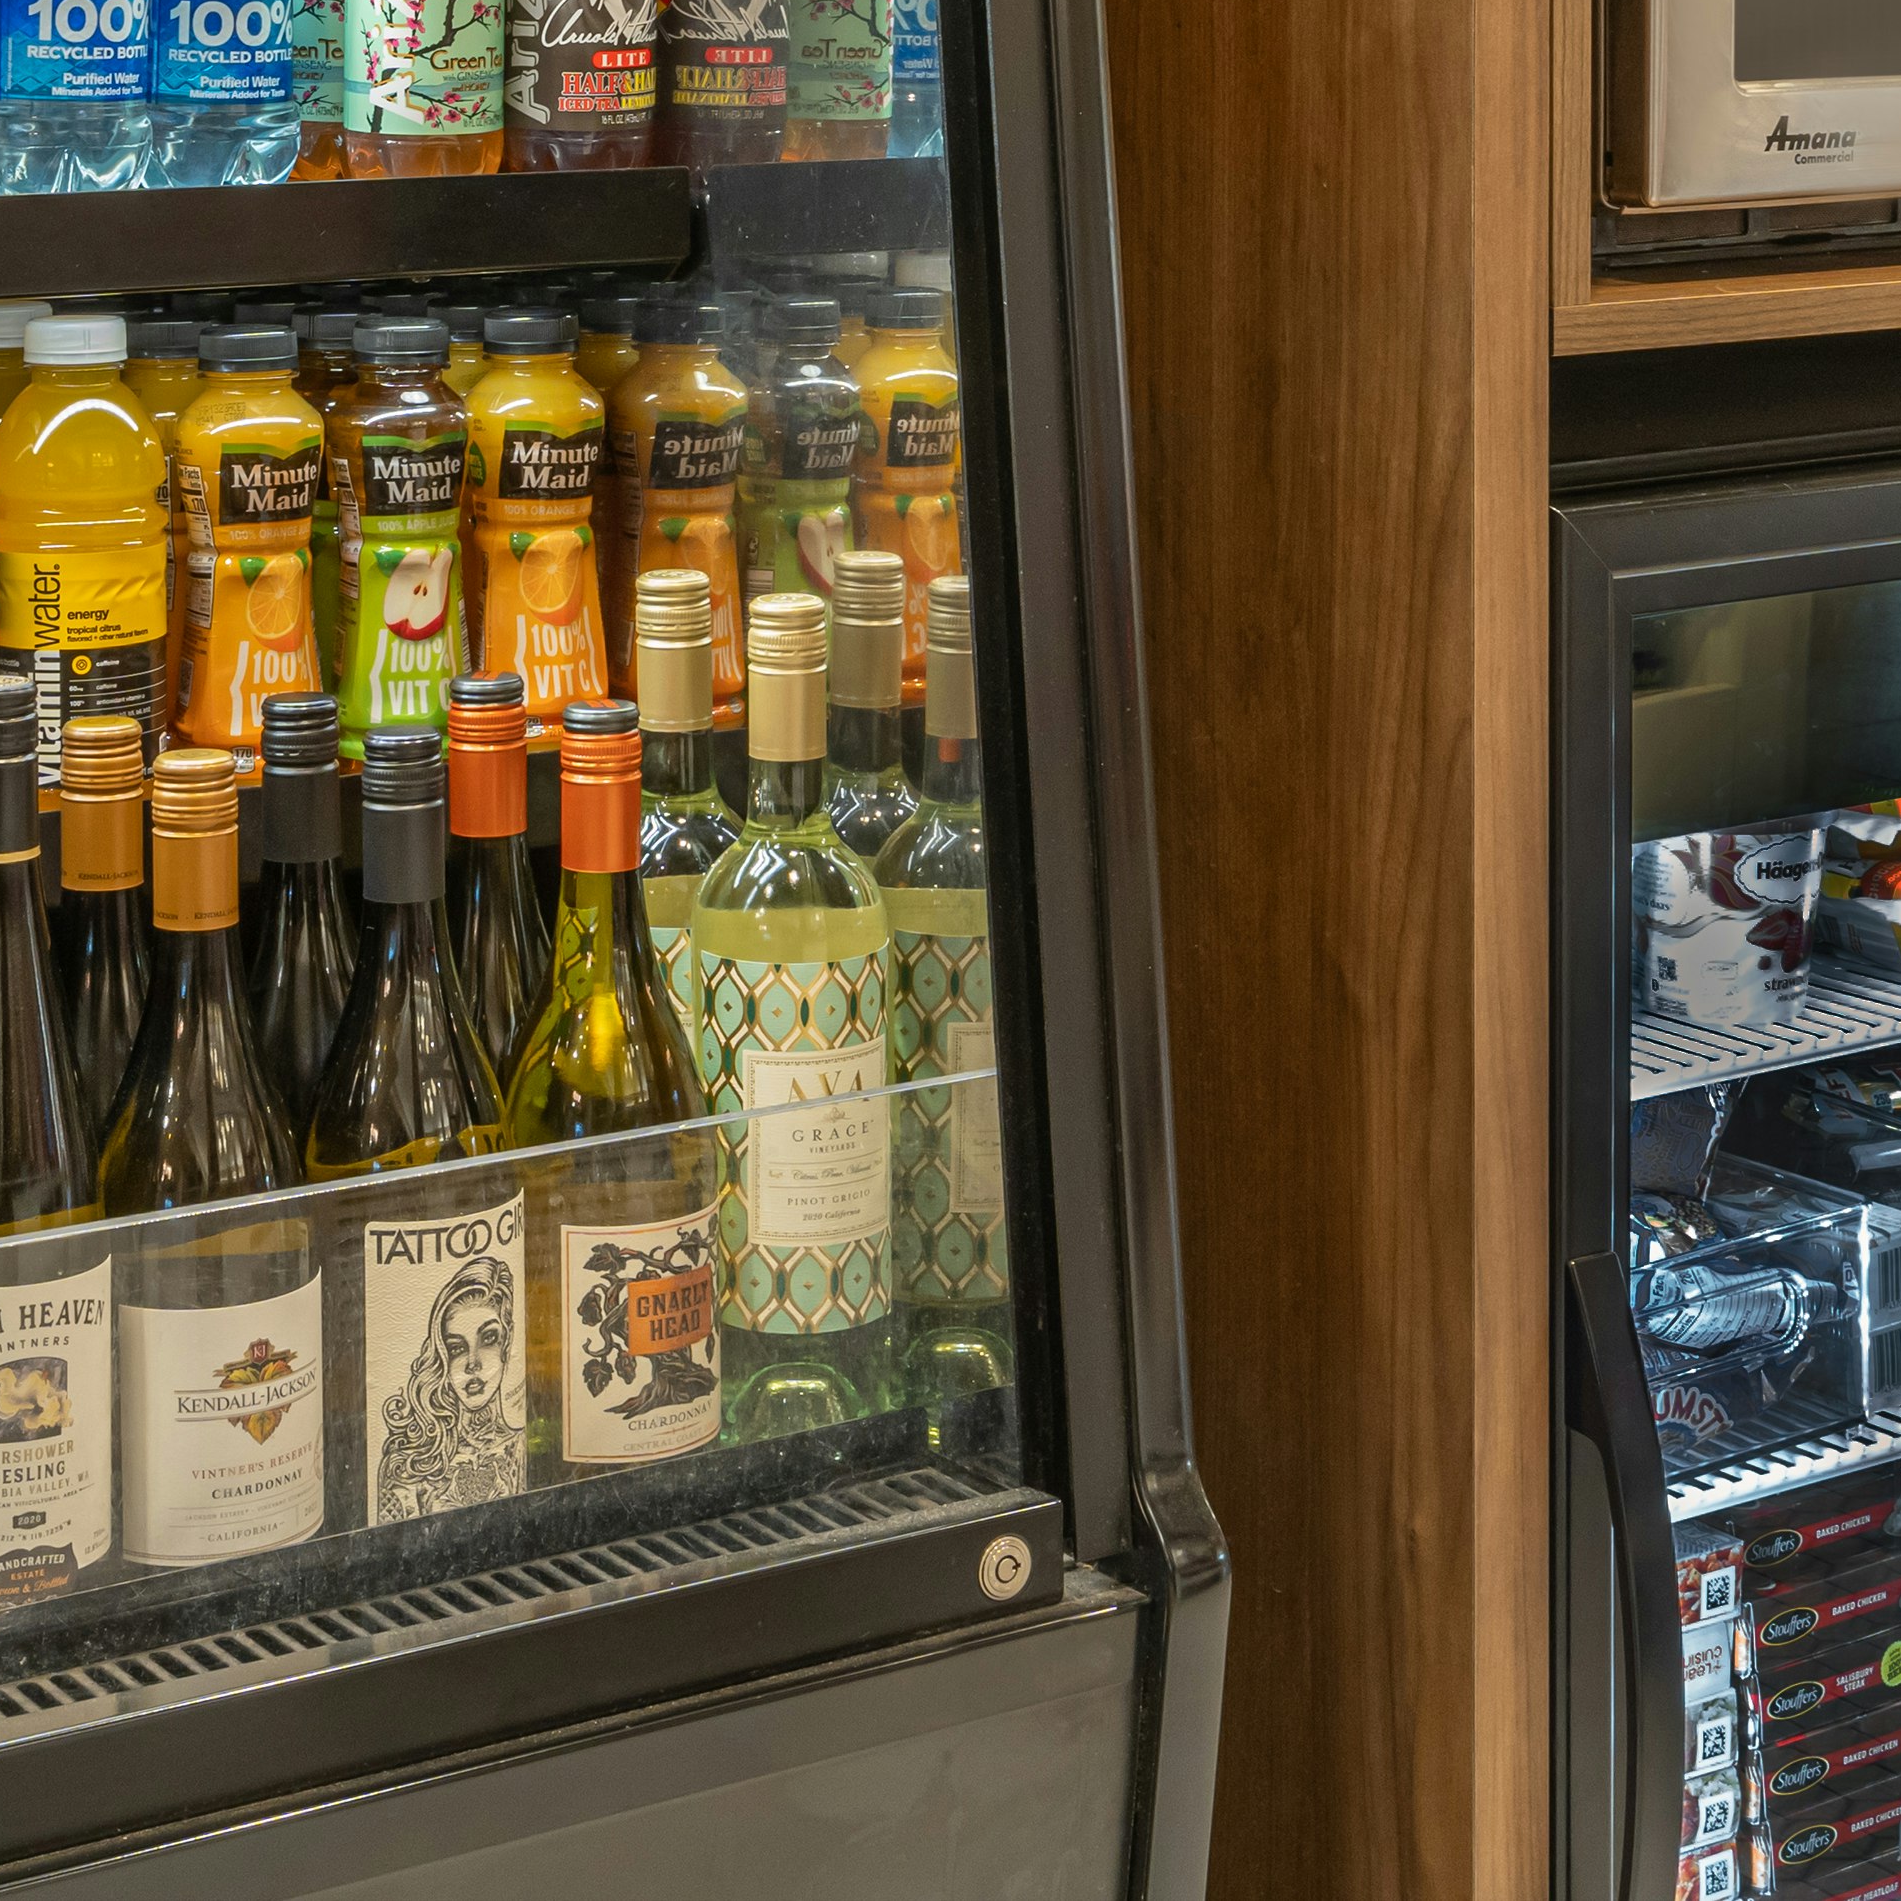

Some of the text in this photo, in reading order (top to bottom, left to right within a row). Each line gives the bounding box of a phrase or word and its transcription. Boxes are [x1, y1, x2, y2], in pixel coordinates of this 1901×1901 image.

[170, 0, 292, 47] 100%
[27, 45, 114, 59] RECYCLED
[169, 50, 251, 63] RECYCLED
[430, 50, 485, 71] Green
[600, 53, 646, 68] LITE
[63, 73, 140, 86] Purified Water
[1765, 116, 1856, 151] Amana
[1794, 150, 1853, 164] Commercial
[231, 460, 318, 490] Minute
[372, 455, 461, 481] Minute
[246, 484, 310, 513] Maid
[387, 478, 453, 504] Maid
[67, 609, 110, 623] energy
[534, 660, 590, 700] VIT C
[388, 681, 432, 716] VIT
[792, 1121, 870, 1143] GRACE
[787, 1188, 871, 1207] PINOT GRIGIO
[370, 1218, 492, 1265] TATTOO
[636, 1280, 710, 1318] GNARLY
[19, 1299, 105, 1330] HEAVEN
[649, 1310, 701, 1342] HEAD
[177, 1372, 317, 1414] KENDALL-JACKSON
[627, 1401, 713, 1432] CHARDONNAY
[212, 1469, 302, 1499] CHARDONNAY
[17, 1513, 42, 1527] 2020
[1816, 1515, 1870, 1539] BAKED CHICKEN
[11, 1569, 45, 1580] ESTATE
[1832, 1592, 1887, 1616] BAKED CHICKEN
[1836, 1668, 1874, 1686] SALISBURY
[1844, 1679, 1865, 1692] STEAK
[1843, 1740, 1898, 1765] BAKED CHICKEN
